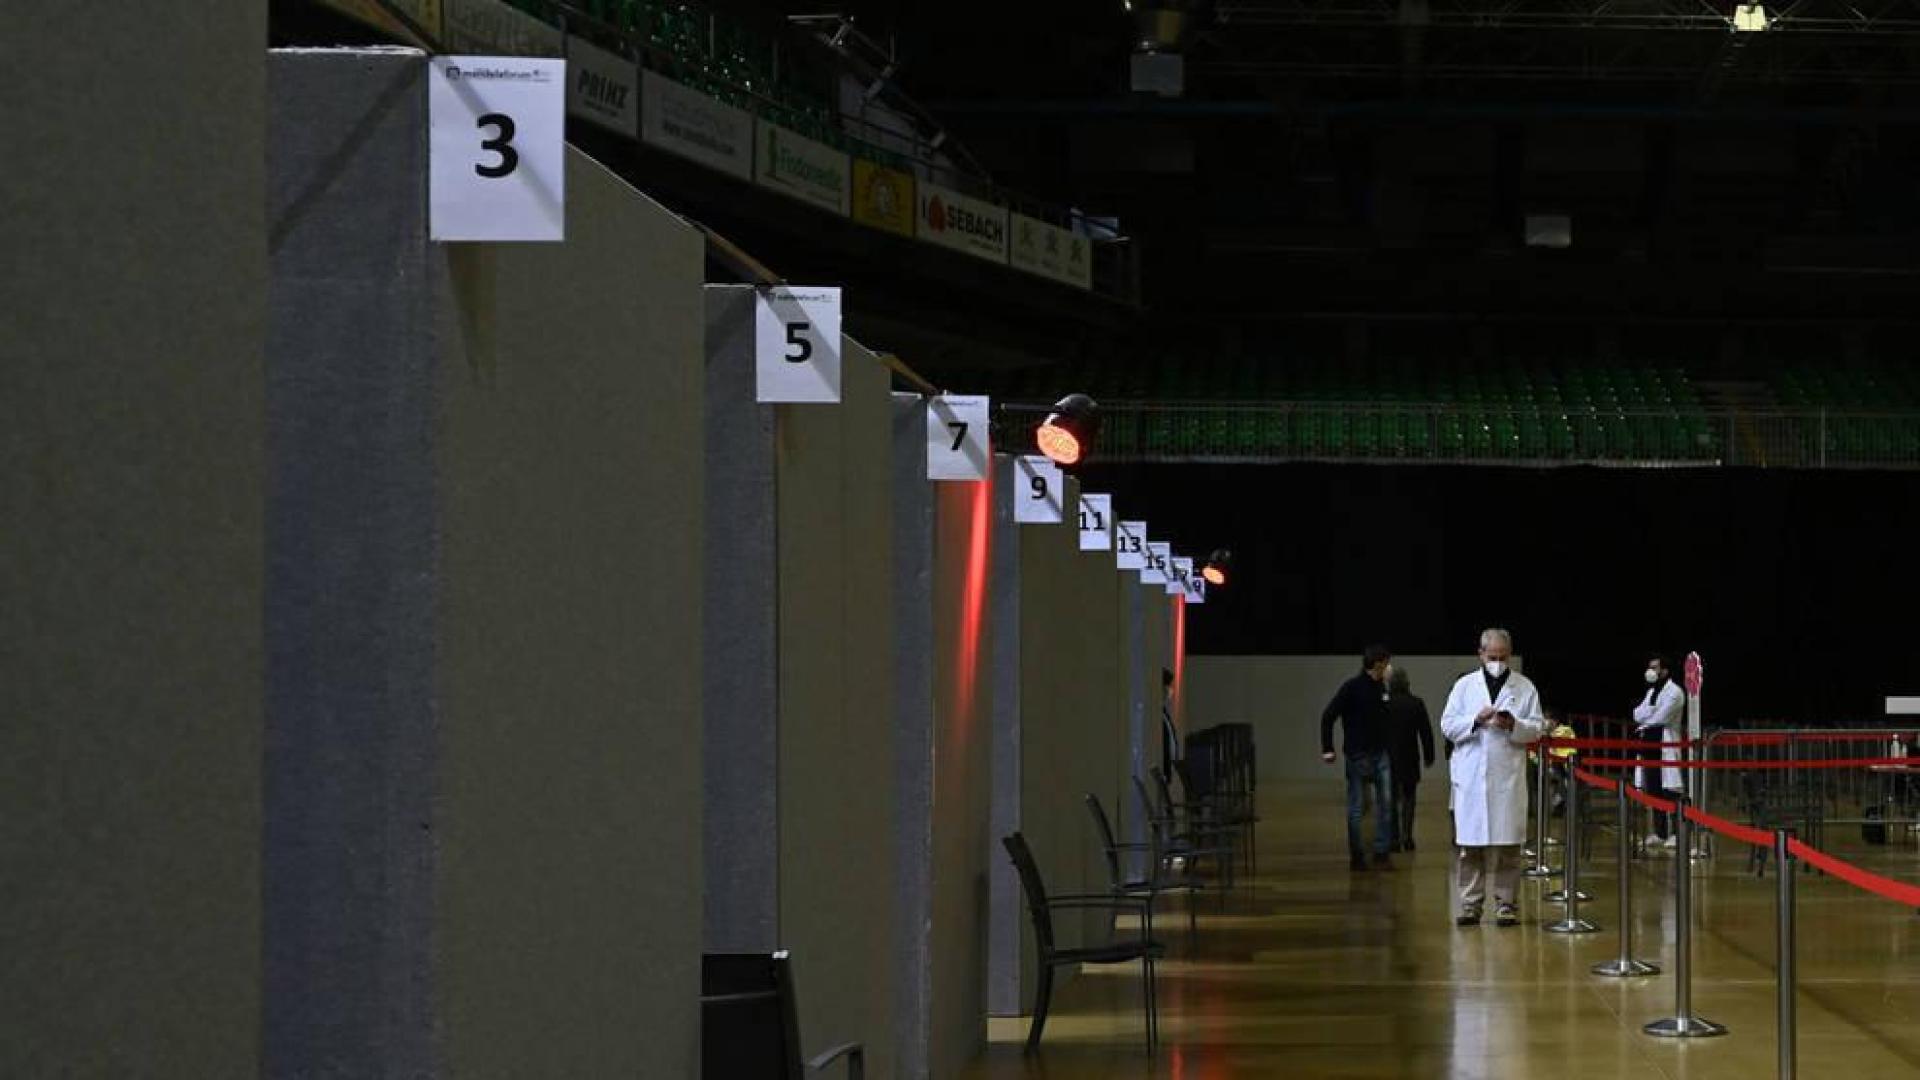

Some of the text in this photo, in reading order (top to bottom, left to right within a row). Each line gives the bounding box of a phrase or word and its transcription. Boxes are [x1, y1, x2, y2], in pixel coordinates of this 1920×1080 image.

[475, 113, 518, 178] 3
[947, 204, 1003, 244] SEBACH
[784, 321, 812, 364] 5
[947, 422, 967, 451] 7
[1031, 477, 1047, 499] 9
[1079, 511, 1105, 531] 11
[1118, 536, 1141, 553] 13
[1145, 555, 1166, 571] 15
